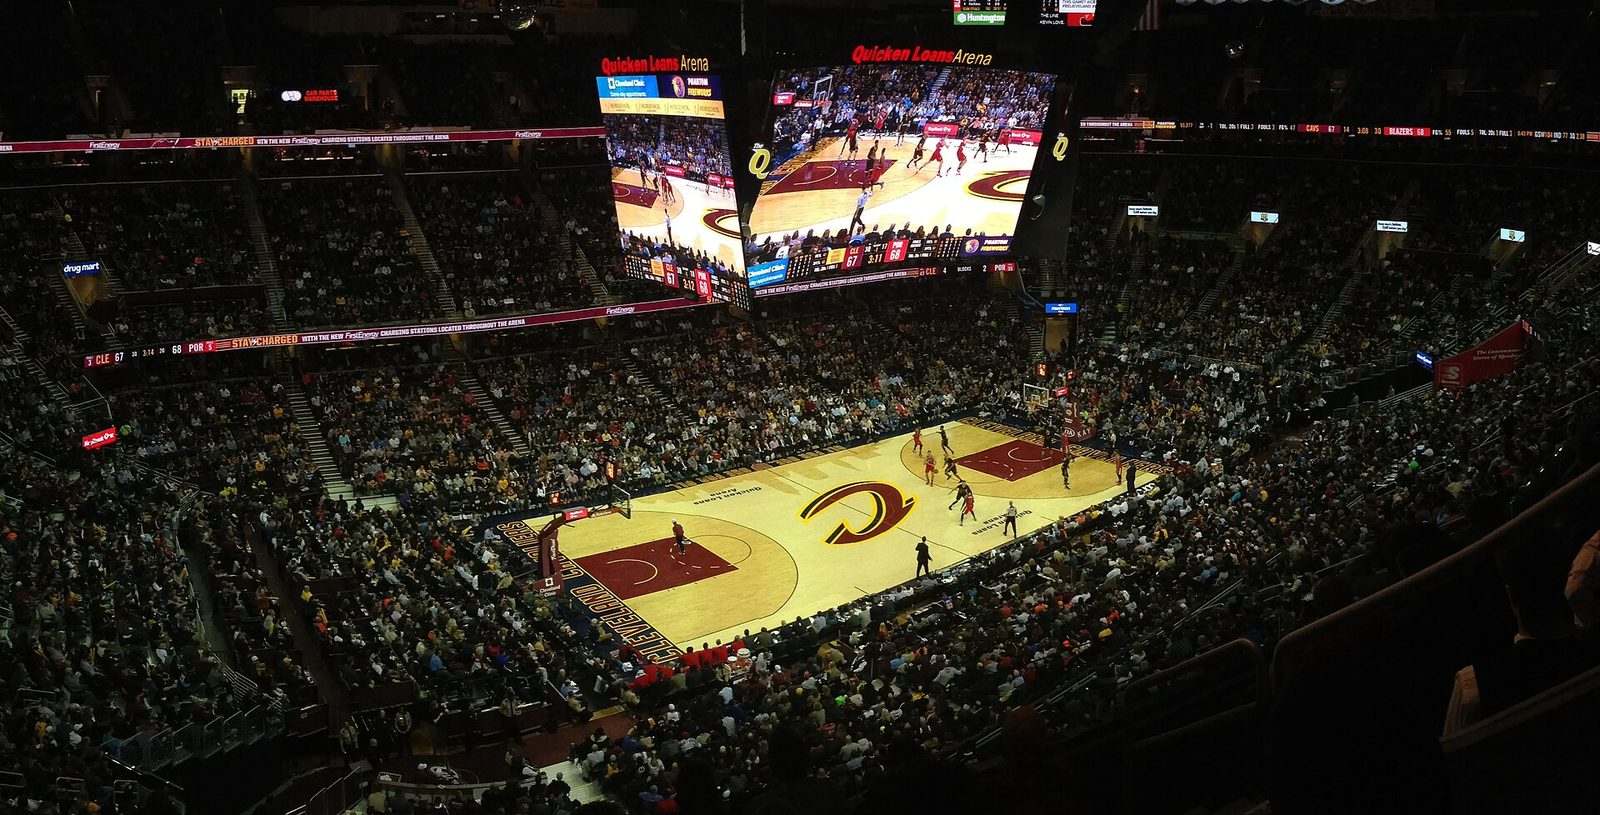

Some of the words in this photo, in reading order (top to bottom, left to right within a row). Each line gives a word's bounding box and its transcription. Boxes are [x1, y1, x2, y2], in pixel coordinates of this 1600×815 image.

[967, 13, 1005, 23] Huntington
[852, 45, 911, 64] Quicken
[911, 46, 953, 63] Loans
[952, 49, 993, 66] Arena
[602, 56, 648, 74] Quicken
[649, 55, 679, 72] Loans
[681, 54, 709, 72] Arena
[1305, 124, 1320, 132] CAVS
[1327, 125, 1335, 133] 67
[1389, 127, 1413, 136] BLAZERS
[1416, 128, 1424, 136] 68
[515, 131, 543, 139] FirstEnergy
[89, 141, 120, 150] FirstEnergy
[1052, 136, 1069, 162] Q
[748, 148, 771, 180] Q
[850, 247, 860, 255] CLE
[889, 249, 901, 261] 68
[846, 255, 858, 268] 67
[868, 254, 883, 264] 3:11
[63, 264, 81, 274] drug
[81, 262, 100, 271] mart
[925, 267, 937, 275] CLE
[942, 266, 947, 274] 4
[982, 264, 987, 272] 2
[667, 272, 675, 286] 67
[683, 278, 696, 291] 3:12
[606, 306, 635, 315] FirstEnergy
[344, 331, 379, 340] FirstEnergy
[410, 326, 438, 334] STATIONS
[438, 324, 462, 333] LOCATED
[507, 318, 526, 326] ARENA
[142, 348, 155, 358] 3:14
[172, 344, 182, 354] 68
[188, 343, 204, 353] POR
[88, 359, 92, 367] 3
[95, 353, 111, 365] CLE
[114, 351, 124, 362] 67
[709, 488, 737, 497] Arena
[723, 486, 762, 498] Quicken
[693, 495, 723, 505] Loans
[971, 523, 999, 535] Loans
[571, 583, 683, 665] CLEVELAND
